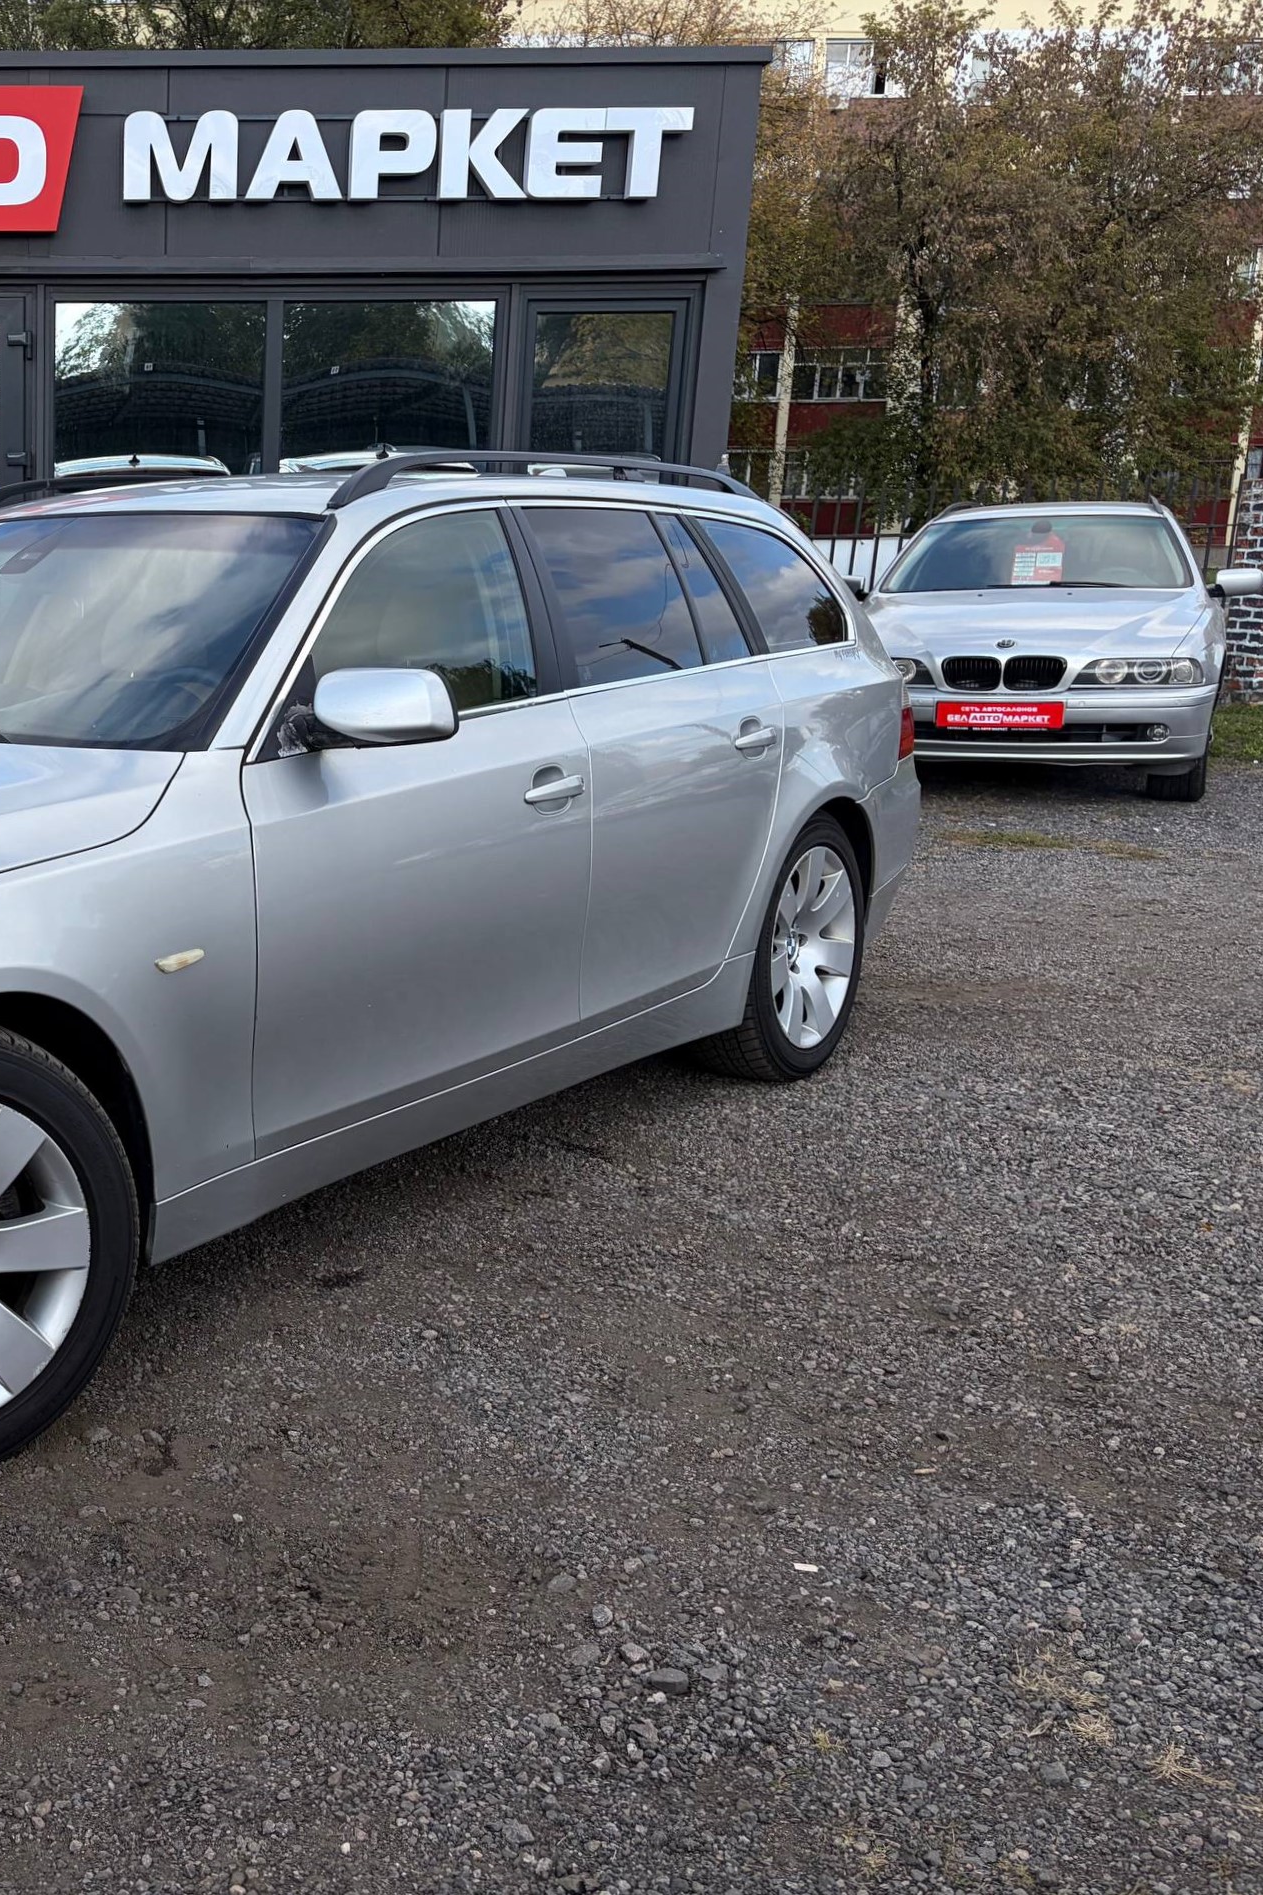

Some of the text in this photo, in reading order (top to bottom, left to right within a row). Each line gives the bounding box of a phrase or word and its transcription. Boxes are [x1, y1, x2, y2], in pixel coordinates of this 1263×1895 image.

[123, 106, 696, 203] МАРКЕТ
[946, 714, 1051, 724] БЕЛ АВТО МАРКЕТ
